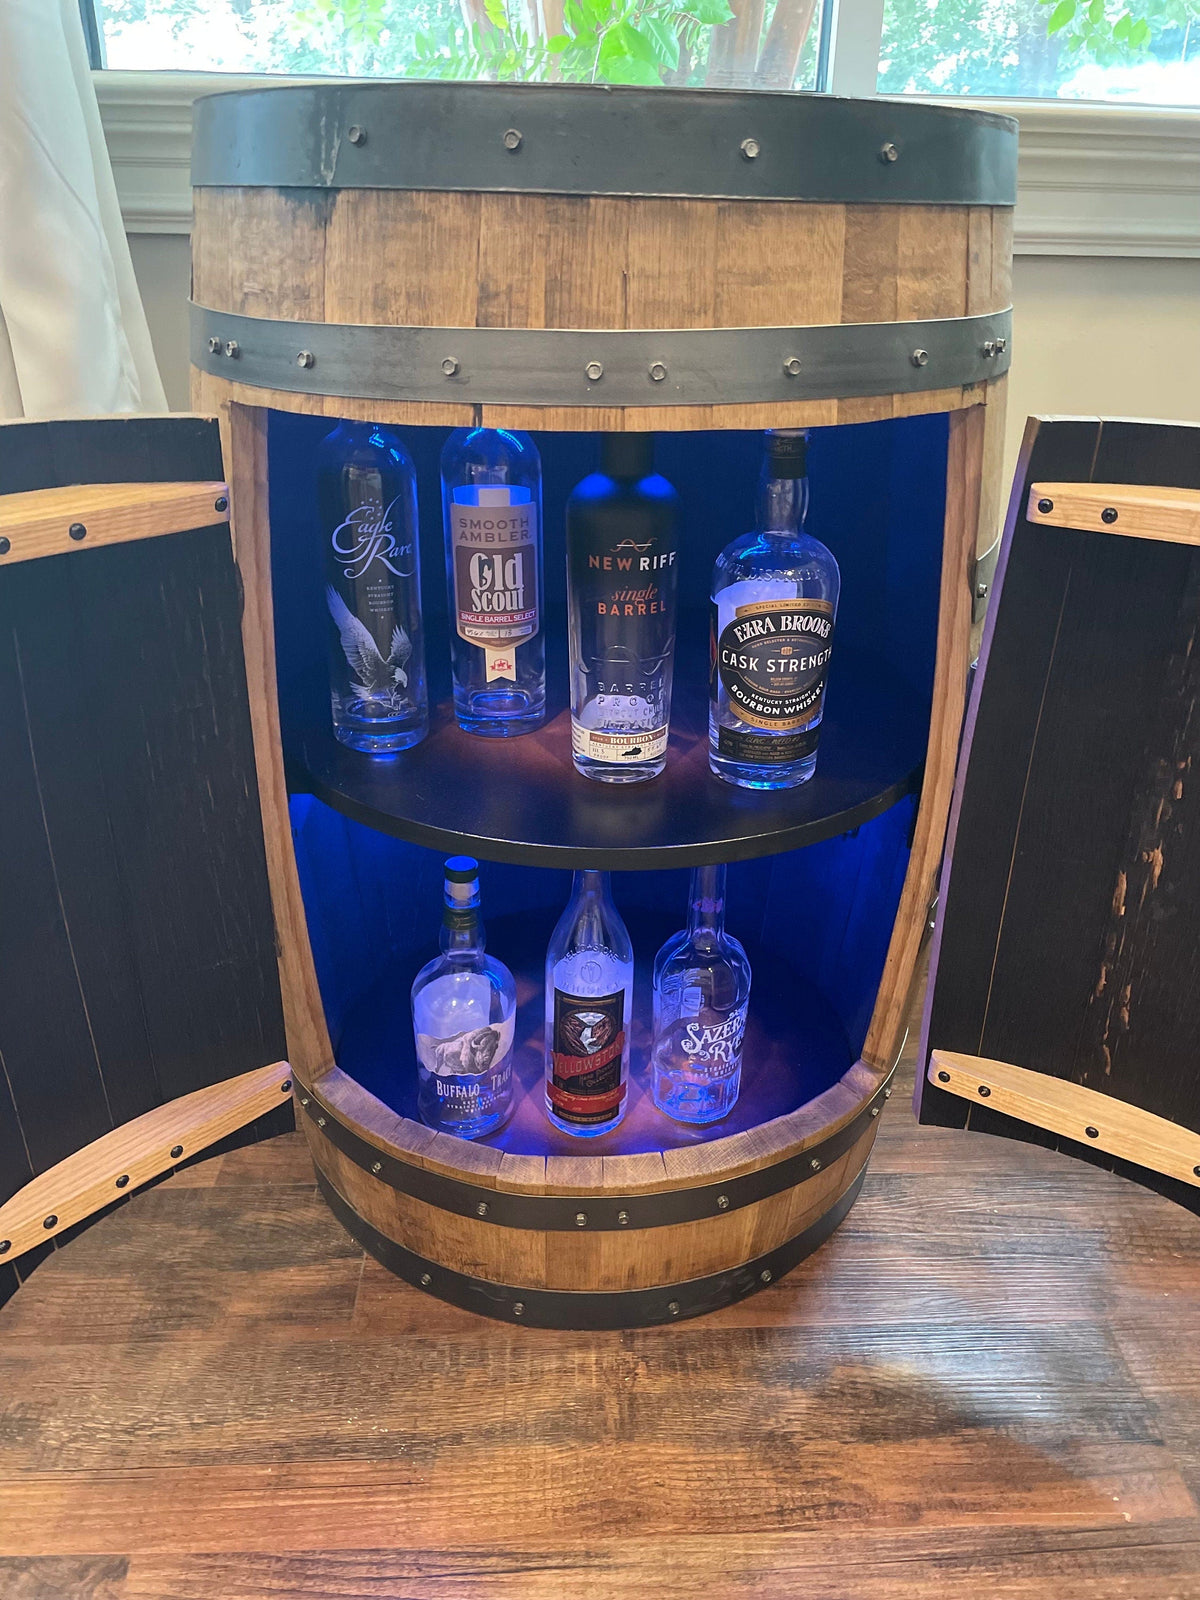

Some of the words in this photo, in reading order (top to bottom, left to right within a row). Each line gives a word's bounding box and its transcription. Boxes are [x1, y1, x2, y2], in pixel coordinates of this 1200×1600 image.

[332, 494, 401, 564] Eagle
[459, 517, 529, 531] SMOOTH
[459, 529, 530, 543] AMBLER
[343, 533, 415, 579] Rare
[588, 554, 633, 571] NEW
[639, 551, 677, 571] RIFF
[469, 552, 524, 591] Old
[471, 588, 524, 612] Scout
[610, 582, 658, 606] single
[461, 612, 484, 623] SINGLE
[513, 610, 536, 621] SELECT
[597, 600, 667, 616] BARREL
[733, 616, 776, 643] EZRA
[780, 615, 832, 639] BROOKS
[722, 649, 760, 672] CASK
[730, 684, 780, 715] BOURBON
[783, 680, 824, 715] WHISKEY
[751, 693, 783, 705] KENTUCKY
[785, 690, 812, 705] STRAIGHT
[750, 716, 778, 727] SINGLE
[610, 735, 654, 745] BOURBON
[436, 1079, 480, 1098] BUFFALO
